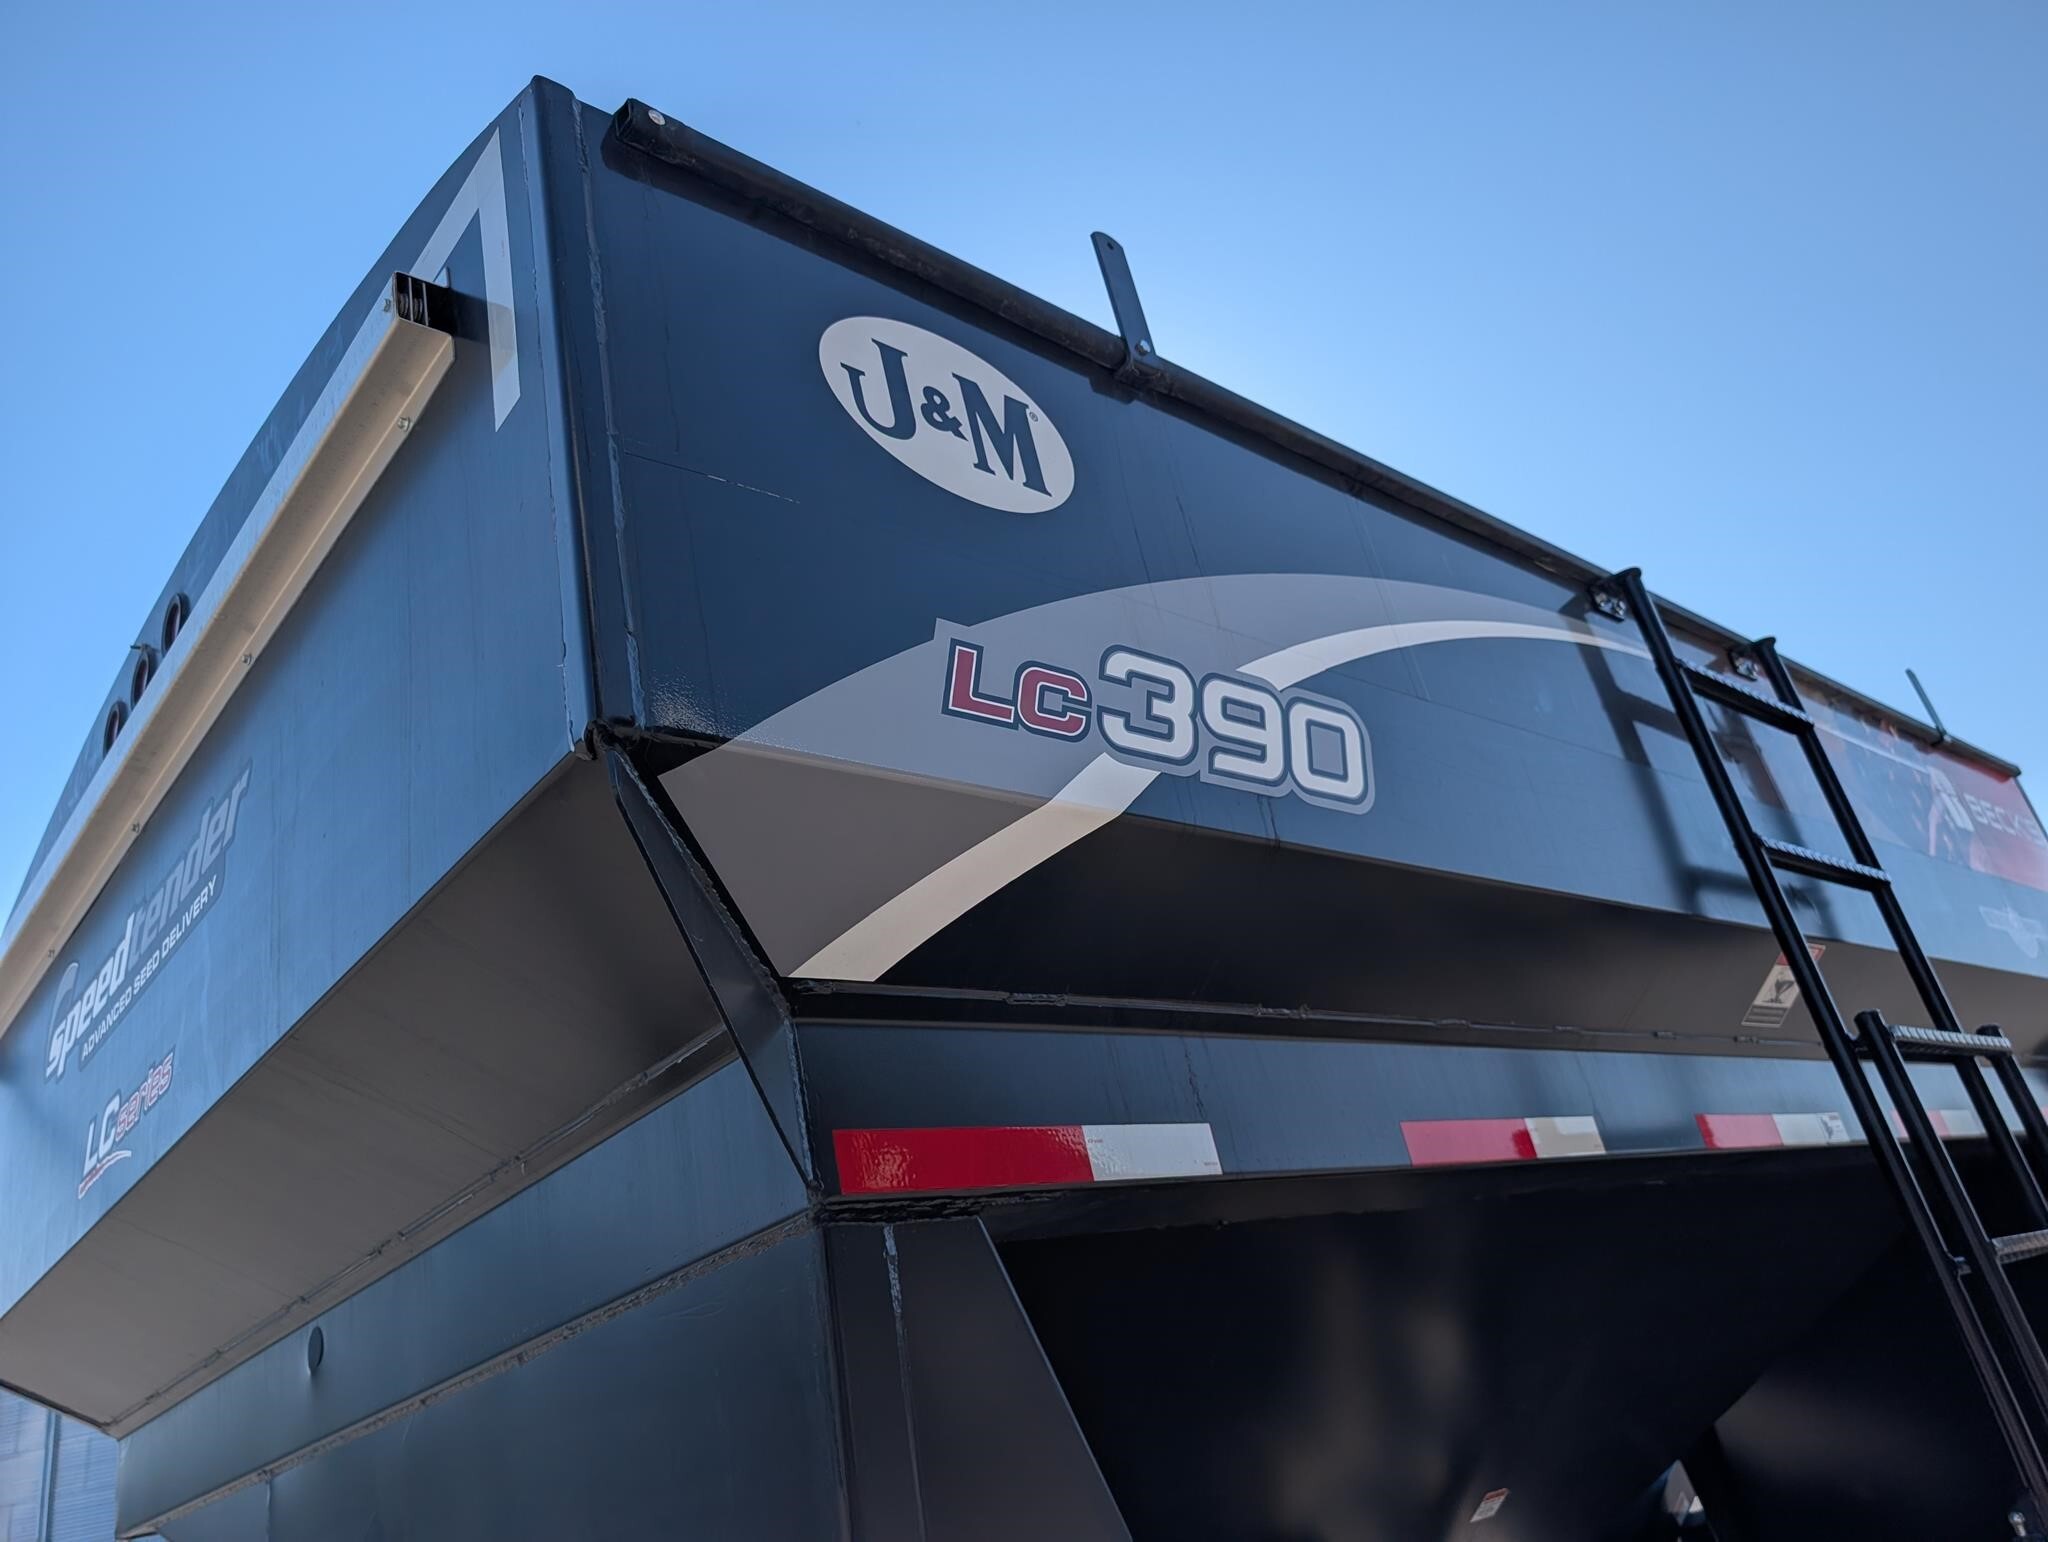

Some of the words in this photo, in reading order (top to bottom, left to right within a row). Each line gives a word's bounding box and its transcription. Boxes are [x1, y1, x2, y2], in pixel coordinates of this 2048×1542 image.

[81, 986, 132, 1062] ADVANCED
[133, 949, 161, 995] SEED
[161, 874, 217, 959] DELIVERY
